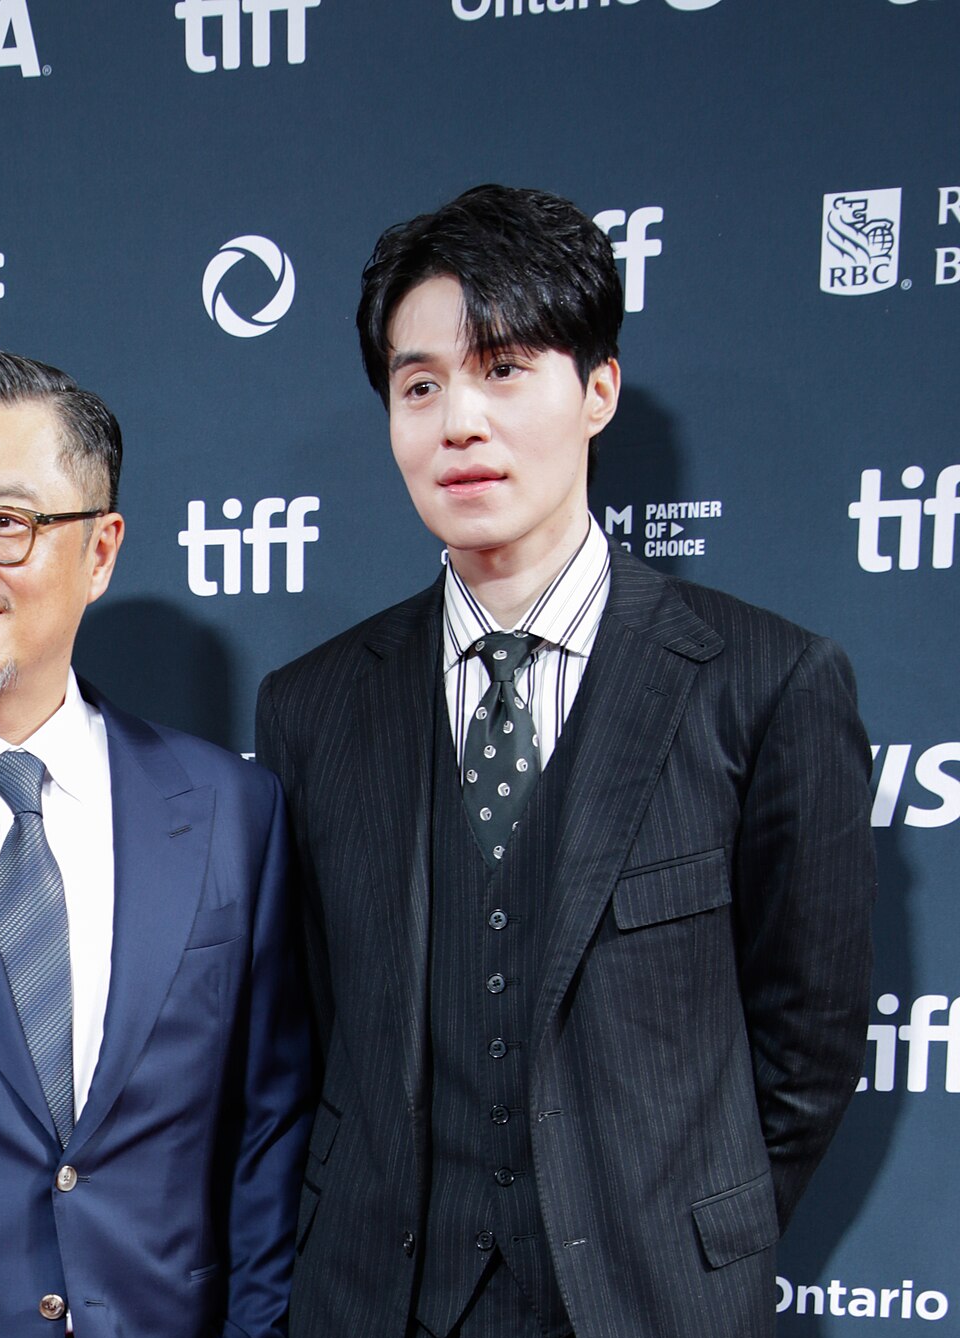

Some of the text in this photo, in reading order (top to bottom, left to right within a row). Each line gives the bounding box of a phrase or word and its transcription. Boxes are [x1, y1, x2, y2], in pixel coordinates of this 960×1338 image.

[174, 0, 322, 74] tiff
[829, 263, 890, 288] RBC
[645, 500, 722, 520] PARTNER
[644, 521, 668, 539] OF
[177, 495, 320, 597] tiff
[644, 538, 706, 558] CHOICE
[870, 741, 960, 828] IS
